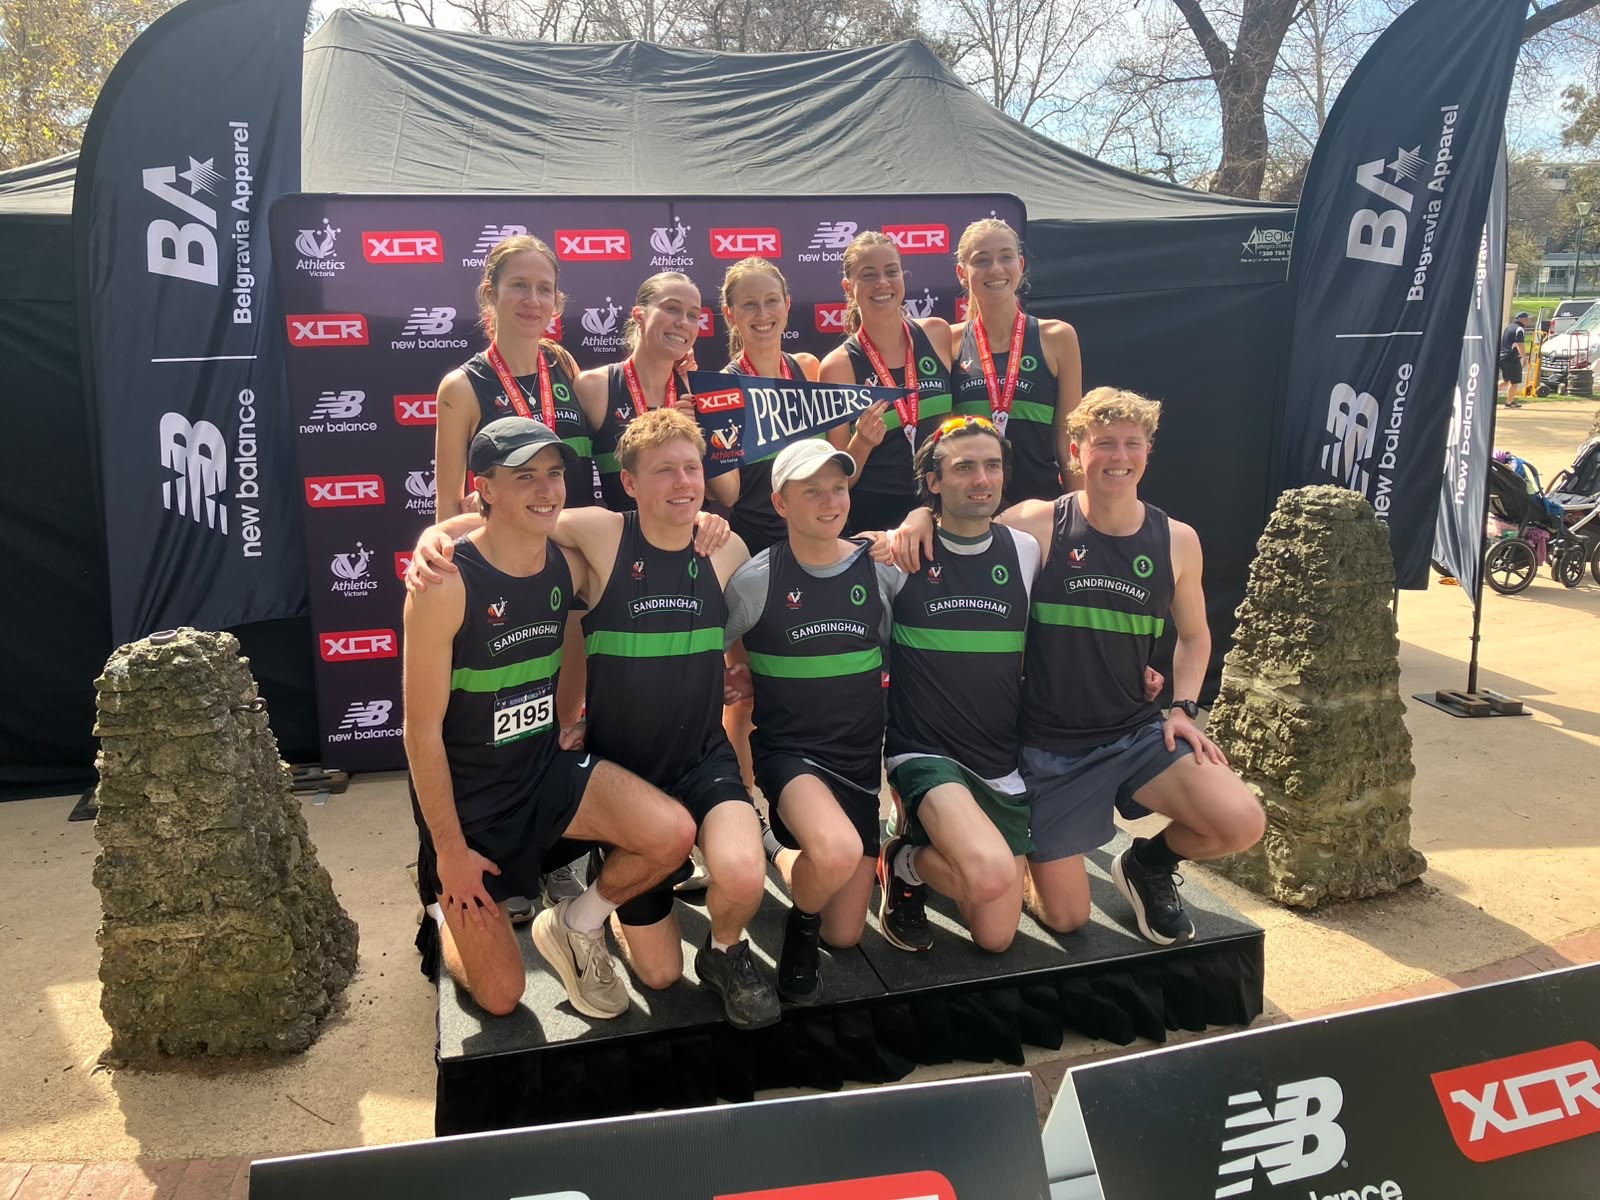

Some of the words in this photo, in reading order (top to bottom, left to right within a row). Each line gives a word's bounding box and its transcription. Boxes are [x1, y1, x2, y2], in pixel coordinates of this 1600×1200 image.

[229, 121, 253, 213] Apparel
[1406, 200, 1442, 301] Belgravia
[1427, 104, 1459, 192] Apparel
[368, 237, 438, 257] XCR
[560, 236, 626, 254] XCR
[714, 234, 776, 252] XCR
[886, 230, 945, 248] XCR
[296, 259, 346, 270] Athletics
[463, 257, 486, 267] new
[650, 256, 694, 266] Athletics
[798, 254, 819, 262] new
[232, 219, 254, 324] Belgravia
[292, 320, 363, 340] XCR
[391, 340, 415, 349] new
[418, 339, 468, 349] balance
[581, 336, 626, 347] Athletics
[399, 401, 438, 419] XC
[700, 393, 741, 409] XCR
[748, 389, 873, 446] PREMIERS
[1378, 363, 1413, 469] balance
[300, 425, 324, 434] new
[327, 422, 377, 432] balance
[1455, 457, 1471, 504] new
[1463, 362, 1480, 455] balance
[234, 388, 259, 498] balance
[711, 449, 745, 460] Athletics
[311, 481, 379, 500] XCR
[405, 499, 437, 509] Athlet
[241, 504, 262, 557] new
[331, 580, 378, 592] Athletics
[1069, 578, 1145, 600] SANDRINGHAM
[929, 599, 1007, 614] SANDRINGHAM
[494, 624, 558, 651] SANDRINGHAM
[791, 622, 865, 640] SANDRINGHAM
[325, 635, 392, 656] XCR
[497, 700, 550, 736] 2195
[328, 734, 352, 742] new
[354, 728, 403, 740] balance
[1450, 1058, 1600, 1142] XCR
